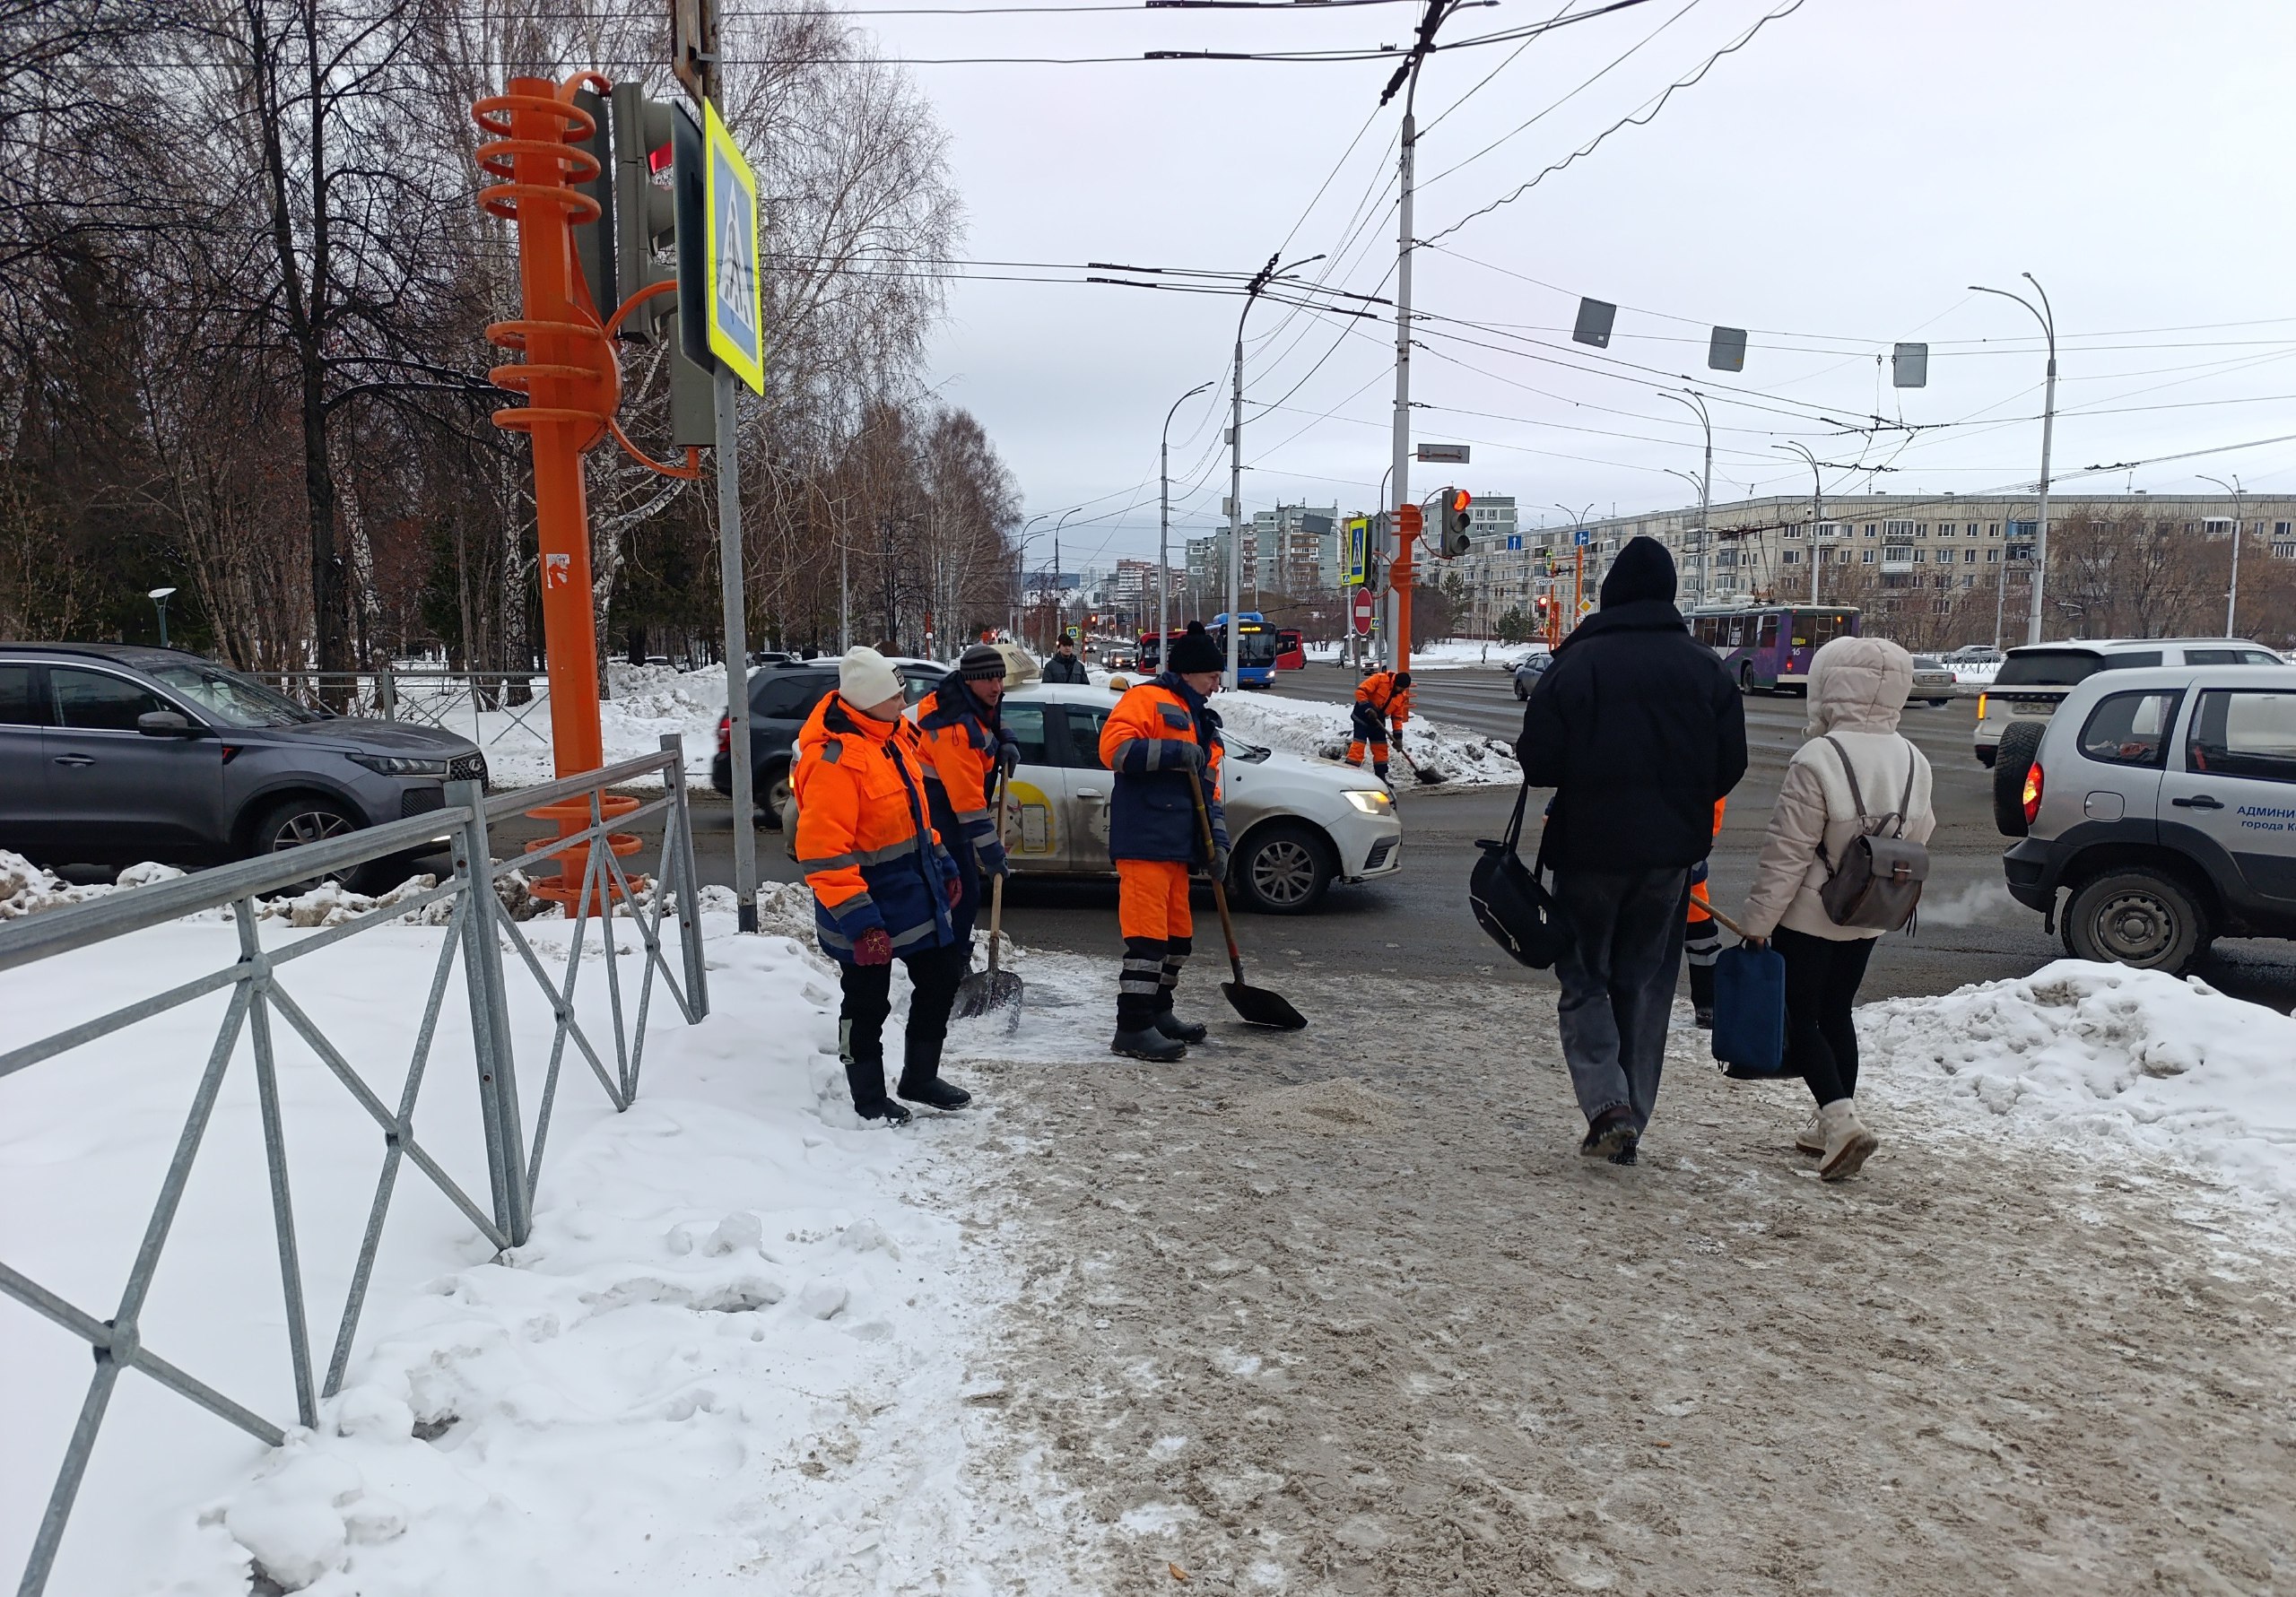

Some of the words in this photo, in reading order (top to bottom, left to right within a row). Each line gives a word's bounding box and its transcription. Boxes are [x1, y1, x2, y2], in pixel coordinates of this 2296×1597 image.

[1792, 647, 1801, 655] 16
[2237, 805, 2296, 819] АДМИНИ
[2241, 820, 2283, 831] города
[2287, 822, 2296, 831] К
